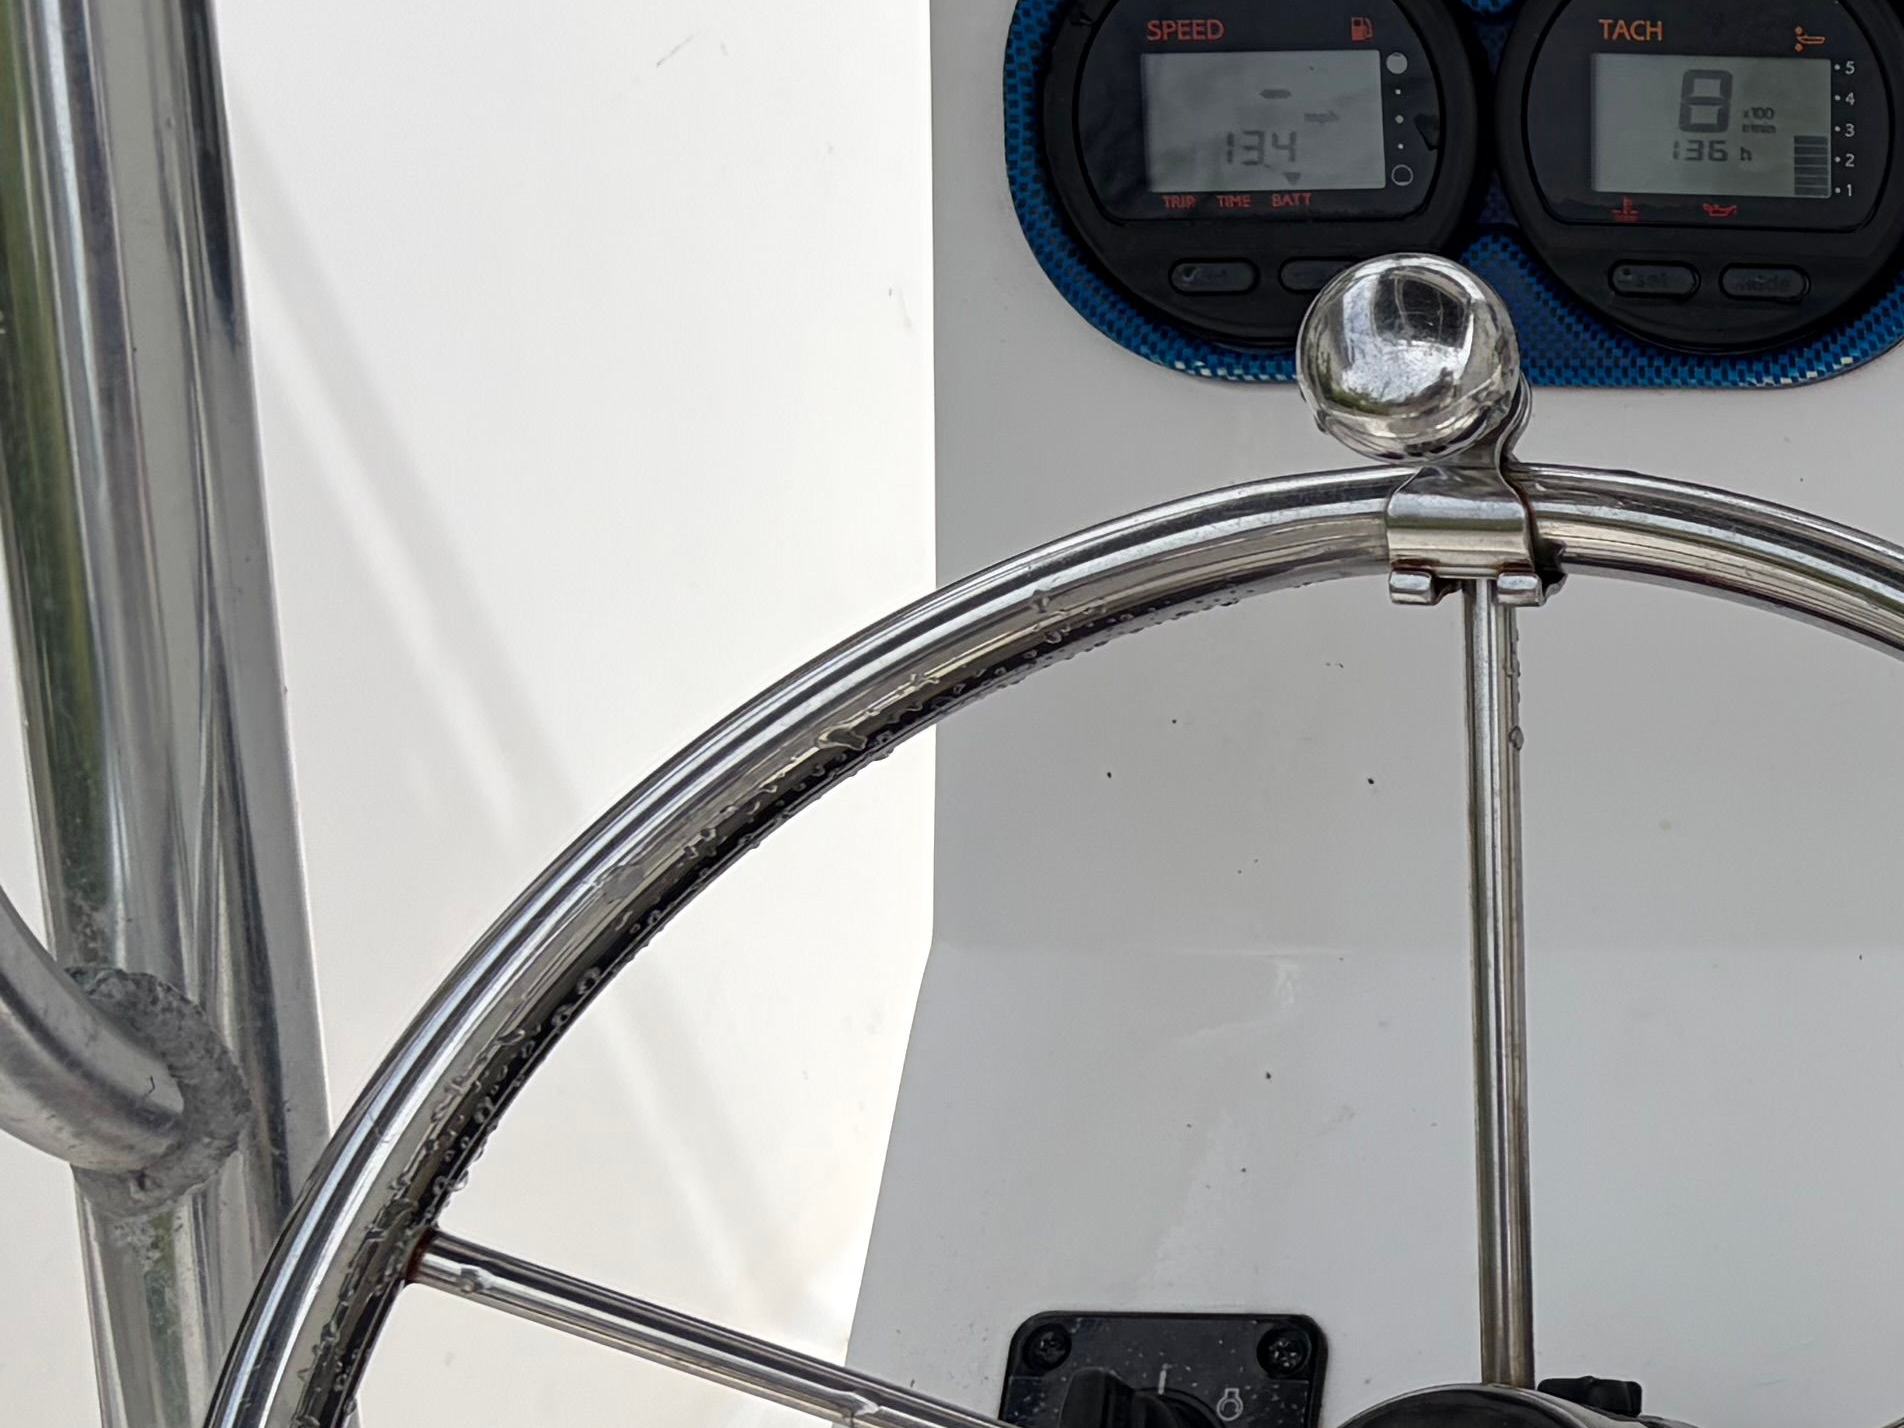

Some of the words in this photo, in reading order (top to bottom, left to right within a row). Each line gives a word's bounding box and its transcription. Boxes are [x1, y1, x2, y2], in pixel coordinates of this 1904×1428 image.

[1146, 19, 1225, 41] SPEED
[1598, 19, 1664, 41] TACH
[1845, 61, 1855, 75] 5
[1678, 68, 1733, 133] 8
[1845, 92, 1855, 105] 4
[1845, 123, 1855, 137] 3
[1672, 139, 1729, 162] 136
[1845, 153, 1855, 167] 2
[1846, 183, 1853, 197] 1
[1161, 195, 1196, 209] TRIP
[1216, 194, 1252, 208] TIME
[1271, 192, 1313, 207] BATT
